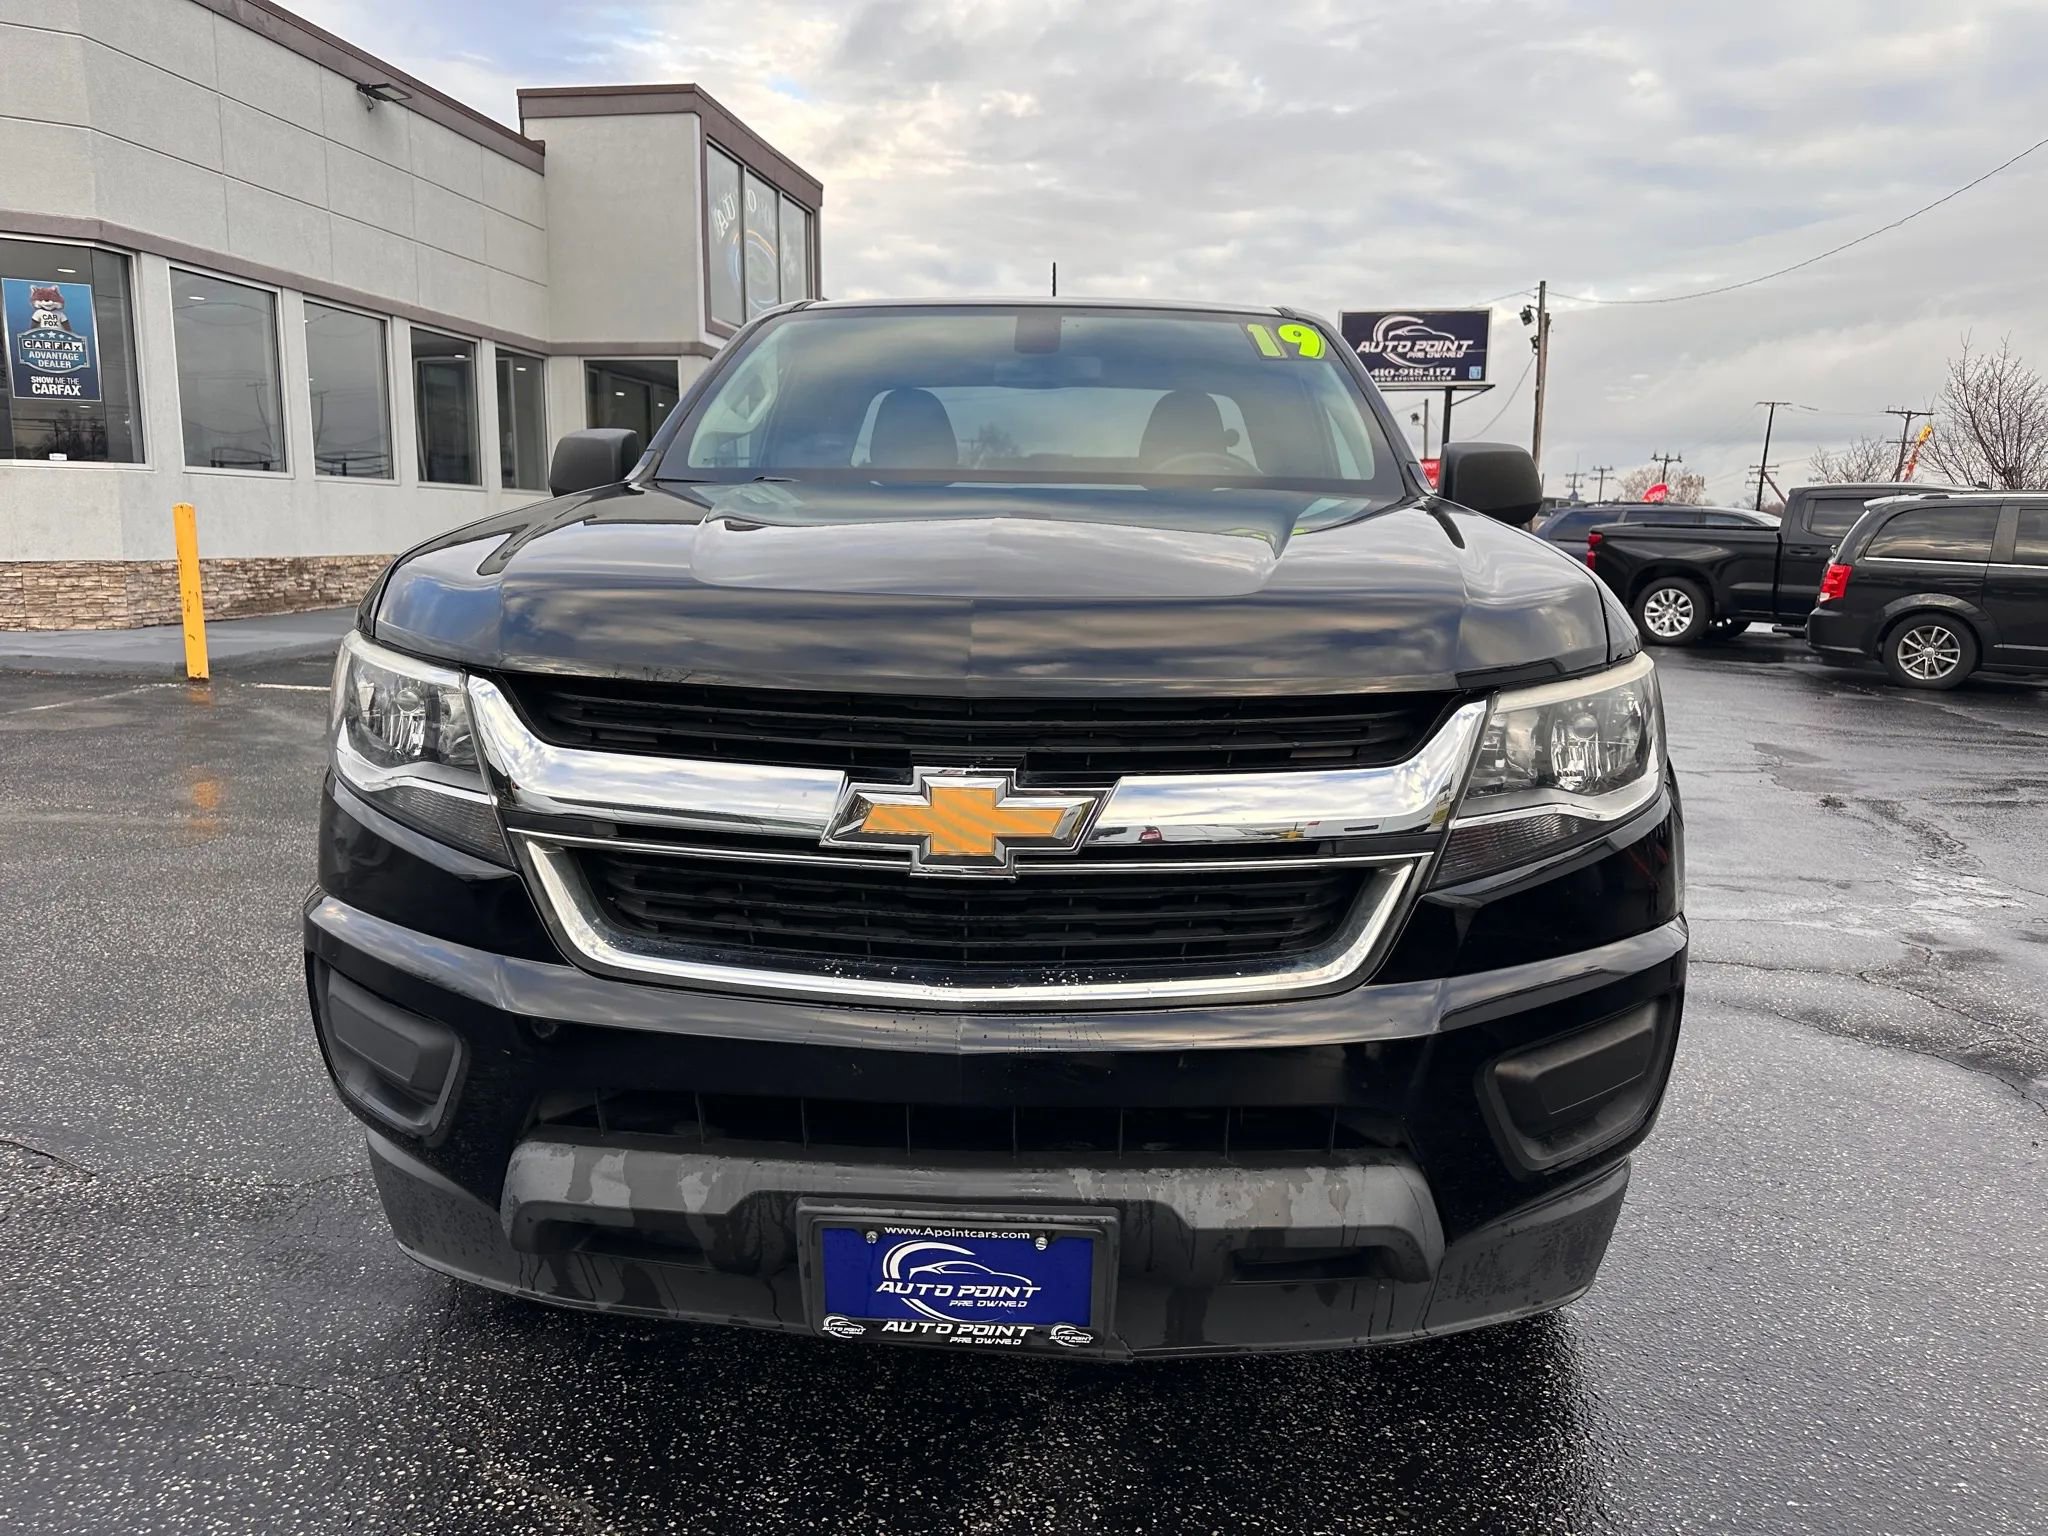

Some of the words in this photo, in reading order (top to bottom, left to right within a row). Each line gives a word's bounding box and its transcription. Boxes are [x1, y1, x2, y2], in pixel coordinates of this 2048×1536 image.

[23, 339, 83, 352] CARFAX
[1247, 323, 1326, 359] 19
[1356, 340, 1412, 353] AUTO
[1413, 340, 1474, 353] POINT
[28, 351, 80, 361] ADVANTAGE
[1406, 351, 1425, 359] PRE
[38, 360, 72, 368] DEALER
[1370, 367, 1456, 377] 410-918-1171
[30, 376, 54, 384] SHOW
[67, 377, 80, 385] THE
[31, 384, 81, 396] CARFAX
[884, 1226, 1030, 1239] www.Apointcars.com
[876, 1281, 953, 1297] AUTO
[957, 1285, 1042, 1298] POINT
[949, 1299, 974, 1307] PRE
[977, 1300, 1028, 1308] OWNED
[882, 1321, 953, 1335] AUTO
[957, 1324, 1035, 1337] POINT
[949, 1336, 972, 1344] PRE
[975, 1337, 1022, 1346] OWNED
